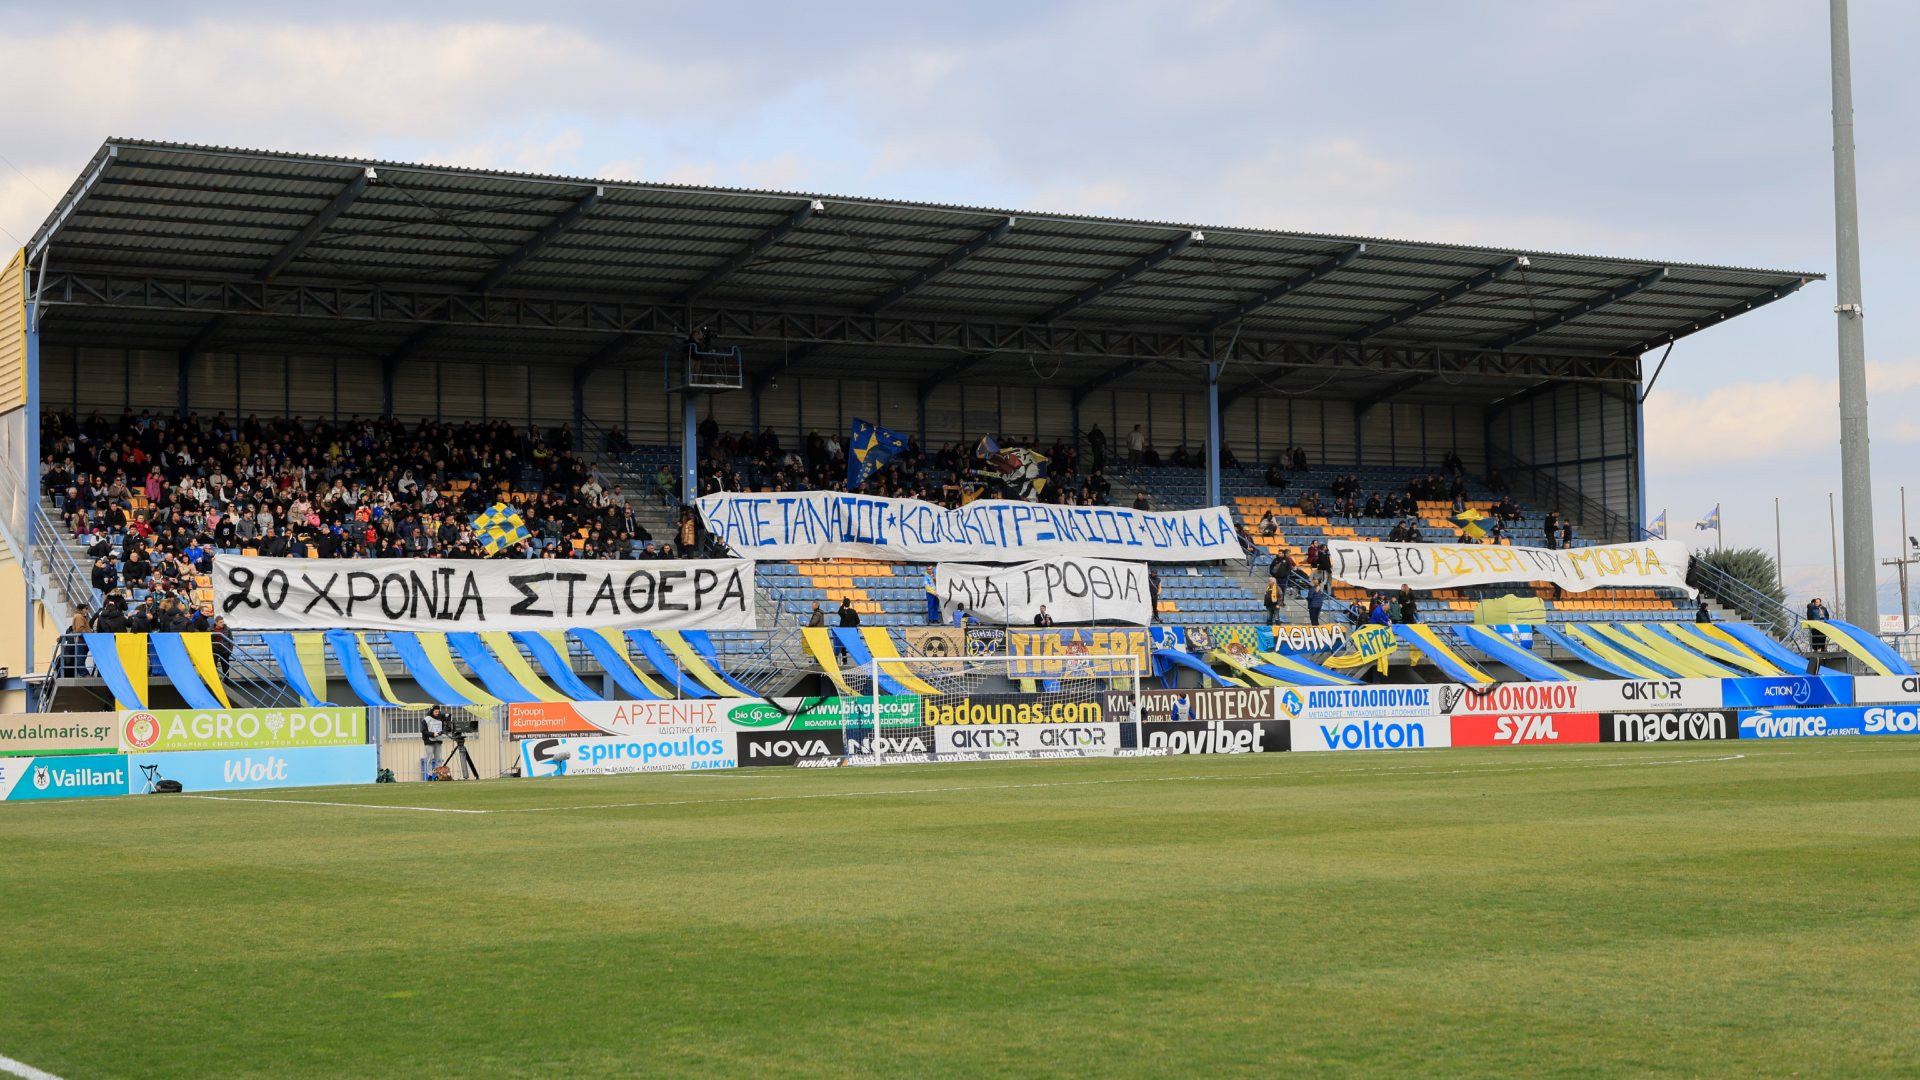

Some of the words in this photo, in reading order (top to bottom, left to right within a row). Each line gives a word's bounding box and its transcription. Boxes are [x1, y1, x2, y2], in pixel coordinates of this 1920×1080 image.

[1143, 515, 1238, 548] ΟΜΑΔΑ
[1338, 548, 1383, 580] ΓΙΑ
[1385, 546, 1424, 577] ΤΟ
[1431, 545, 1526, 575] ΑΣΤΕΡΙ
[1519, 548, 1568, 578] ΤΟΥ
[1568, 547, 1667, 580] ΜΟΡΙΑ
[223, 566, 290, 613] 20
[302, 567, 486, 621] ΧΡΟΝΙΑ
[508, 567, 746, 617] ΣΤΑΘΕΡΑ
[944, 576, 1005, 611] ΜΙΑ
[1024, 561, 1141, 605] ΓΡΟΘΙΑ
[1275, 625, 1346, 652] ΑΘΗΝΑ
[1357, 627, 1397, 657] ΑΡΓΟΣ
[1308, 689, 1430, 709] ΑΠΟΣΤΟΛΟΠΟΥΛΟΣ
[1465, 685, 1577, 711] ΟΙΚΟΝΟΜΟΥ
[1764, 686, 1793, 696] ACTION
[1793, 682, 1808, 697] 24
[512, 708, 544, 716] Σίγουρη
[612, 703, 717, 725] ΑΡΣΕΝΗΣ
[735, 710, 748, 719] bio
[764, 711, 782, 719] eco
[924, 698, 1102, 726] badounas.com
[1195, 689, 1271, 719] ΠΙΤΕΡΟΣ
[166, 713, 260, 740] AGRO
[290, 712, 357, 738] POLI
[1149, 720, 1266, 755] novibet
[1320, 720, 1424, 749] volton
[1493, 715, 1559, 744] SYM
[1613, 712, 1727, 742] macron
[1756, 715, 1827, 737] avance
[1827, 728, 1838, 736] CAR
[1839, 727, 1861, 735] RENTAL
[578, 736, 724, 766] spiropoulos
[749, 739, 831, 758] NOVA
[848, 736, 927, 755] NOVA
[937, 751, 981, 762] novibet
[988, 750, 1032, 761] novibet
[1039, 748, 1081, 759] novibet
[224, 756, 288, 783] Wolt
[691, 759, 736, 769] DAIKIN
[797, 757, 841, 768] novibet
[52, 768, 124, 787] Vaillant
